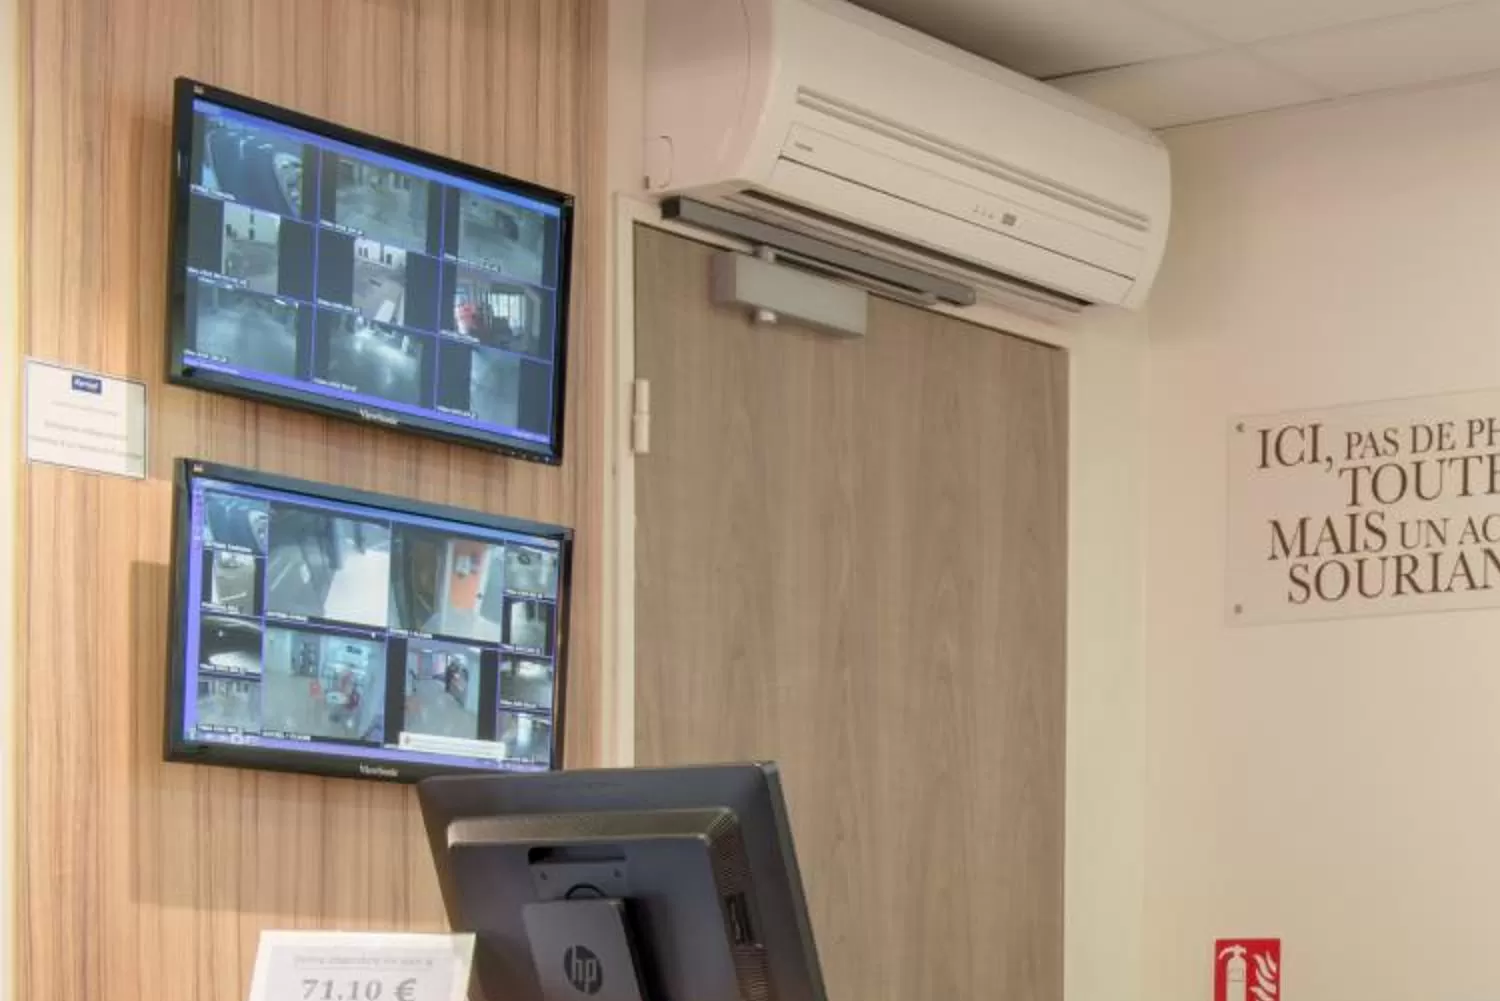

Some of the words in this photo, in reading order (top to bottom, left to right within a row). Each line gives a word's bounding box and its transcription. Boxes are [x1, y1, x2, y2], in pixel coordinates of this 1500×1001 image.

[1256, 421, 1334, 471] ICI,
[1344, 425, 1401, 461] PAS
[1410, 420, 1457, 456] DE
[1266, 511, 1389, 563] MAIS
[1398, 517, 1450, 551] UN
[302, 978, 383, 1001] 71.10
[568, 944, 601, 996] hp
